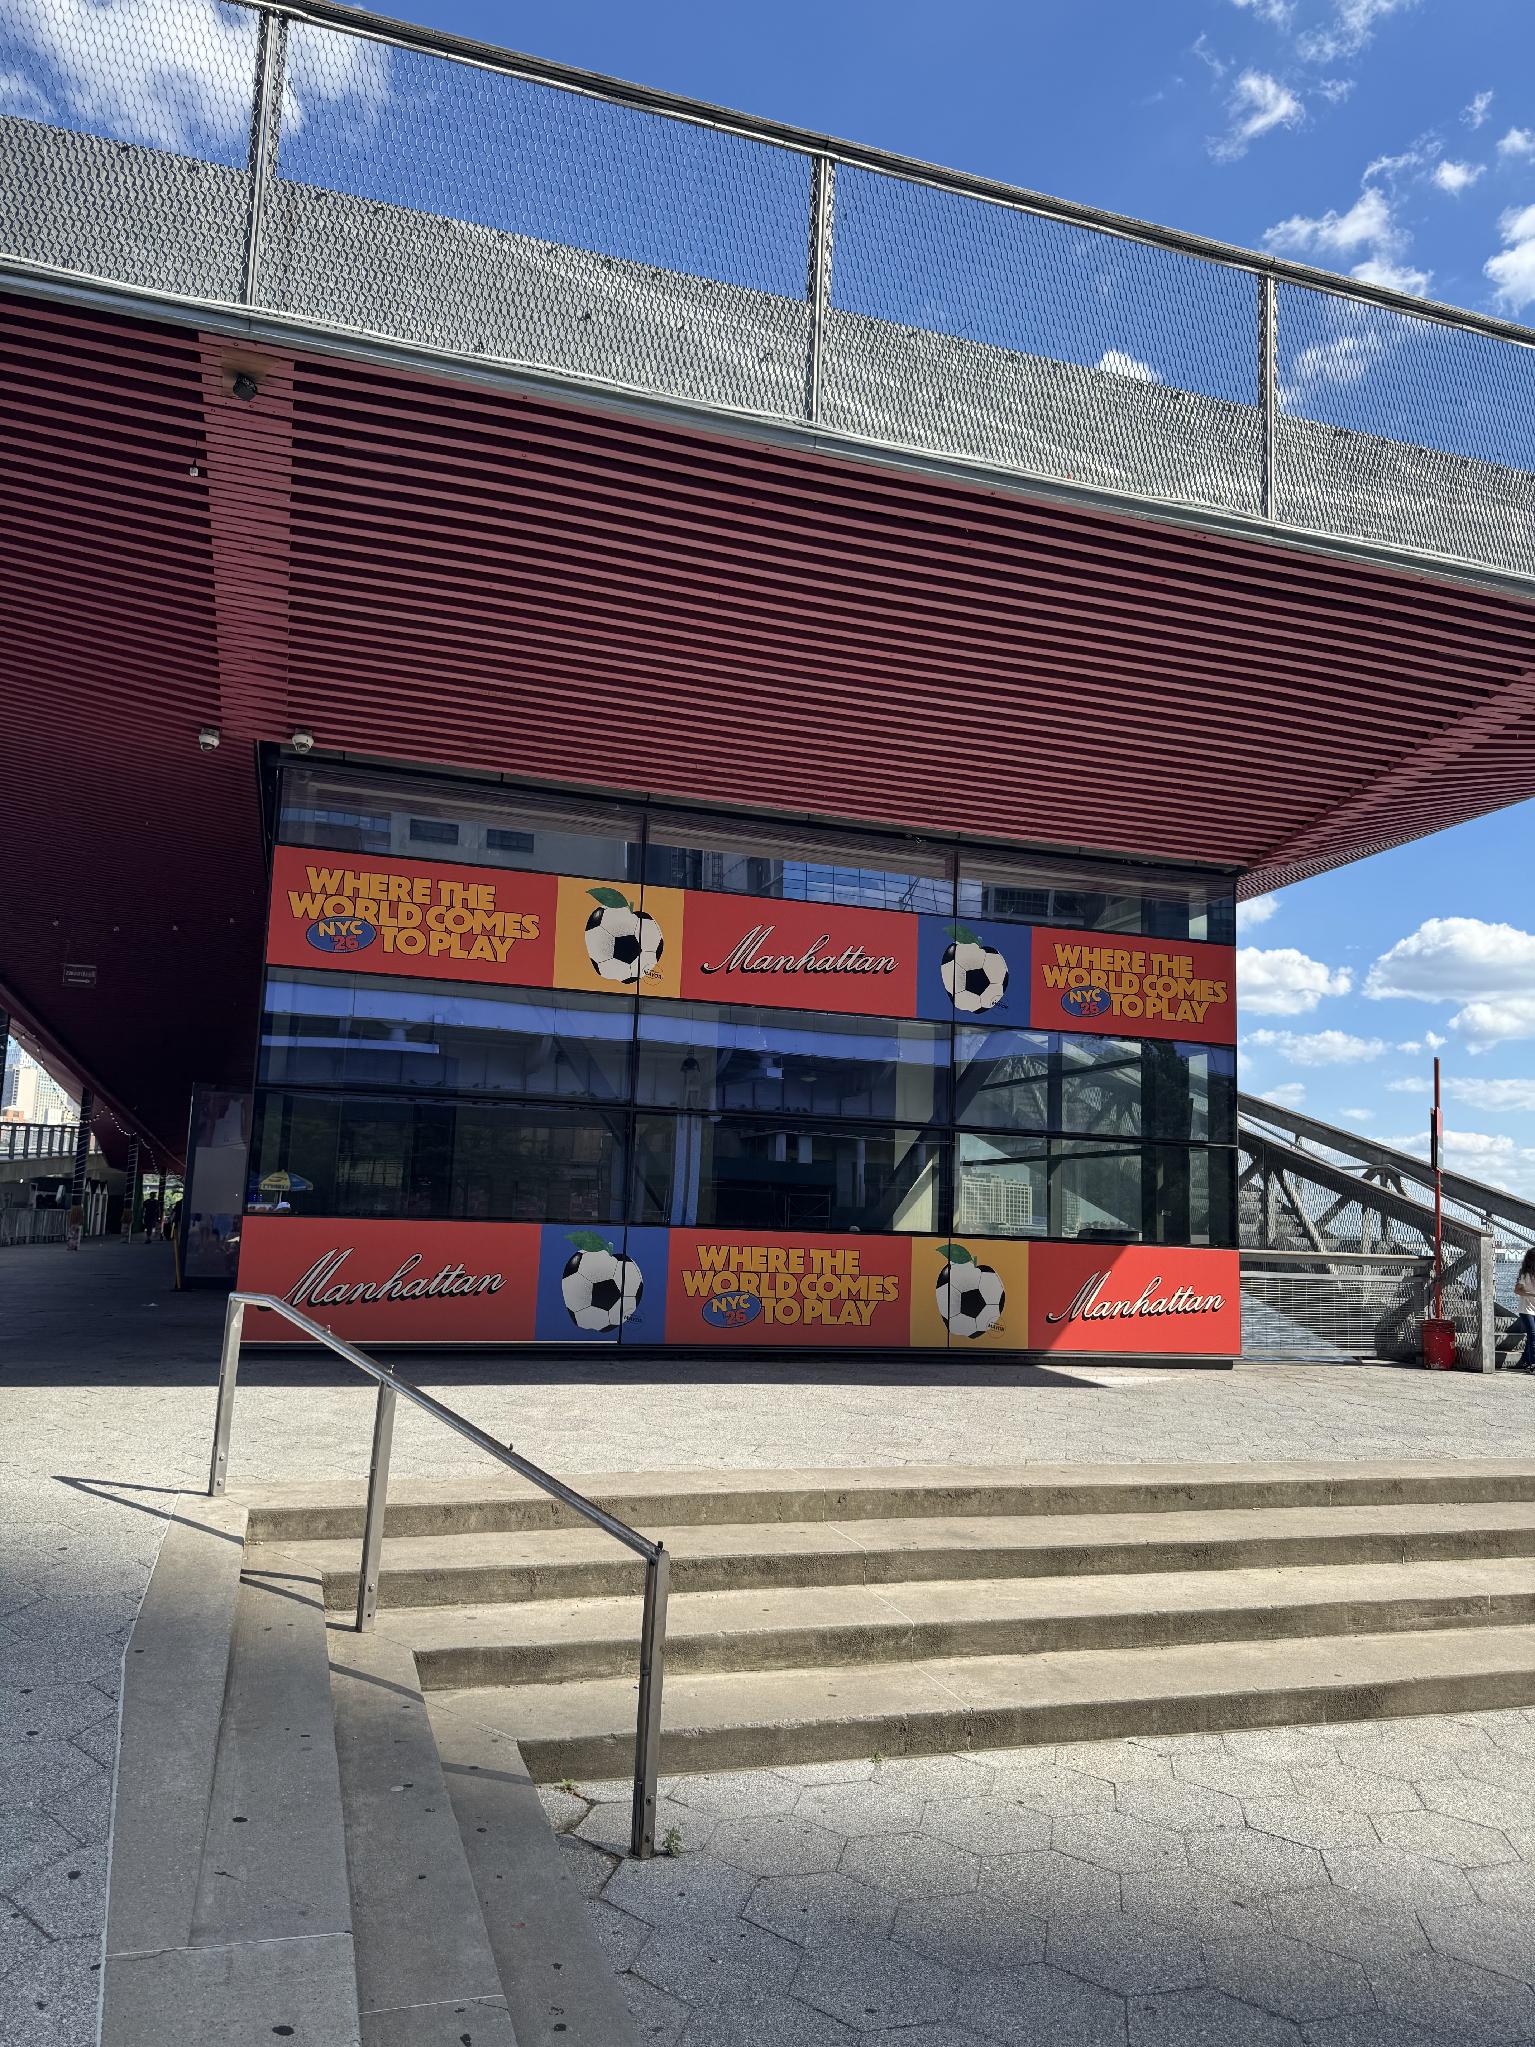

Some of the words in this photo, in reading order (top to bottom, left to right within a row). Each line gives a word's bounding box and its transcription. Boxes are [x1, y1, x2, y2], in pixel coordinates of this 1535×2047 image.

[305, 865, 432, 905] WHERE
[437, 880, 496, 911] THE
[287, 890, 423, 928] WORLD
[425, 905, 540, 940] COMES
[317, 920, 363, 937] NYC
[330, 934, 360, 950] 26
[380, 926, 427, 955] TO
[428, 930, 516, 963] PLAY
[700, 924, 899, 974] Manhattan
[1053, 943, 1146, 974] WHERE
[1149, 953, 1194, 979] THE
[1041, 964, 1140, 995] WORLD
[1142, 974, 1228, 1004] COMES
[1069, 989, 1102, 1004] NYC
[1110, 993, 1144, 1018] TO
[1145, 996, 1211, 1024] PLAY
[696, 1245, 805, 1274] WHERE
[809, 1248, 860, 1275] THE
[257, 1247, 508, 1311] Manhattan
[681, 1270, 798, 1299] WORLD
[800, 1273, 899, 1302] COMES
[711, 1294, 751, 1313] NYC
[761, 1298, 802, 1326] TO
[803, 1299, 879, 1327] PLAY
[1046, 1270, 1225, 1323] Manhattan
